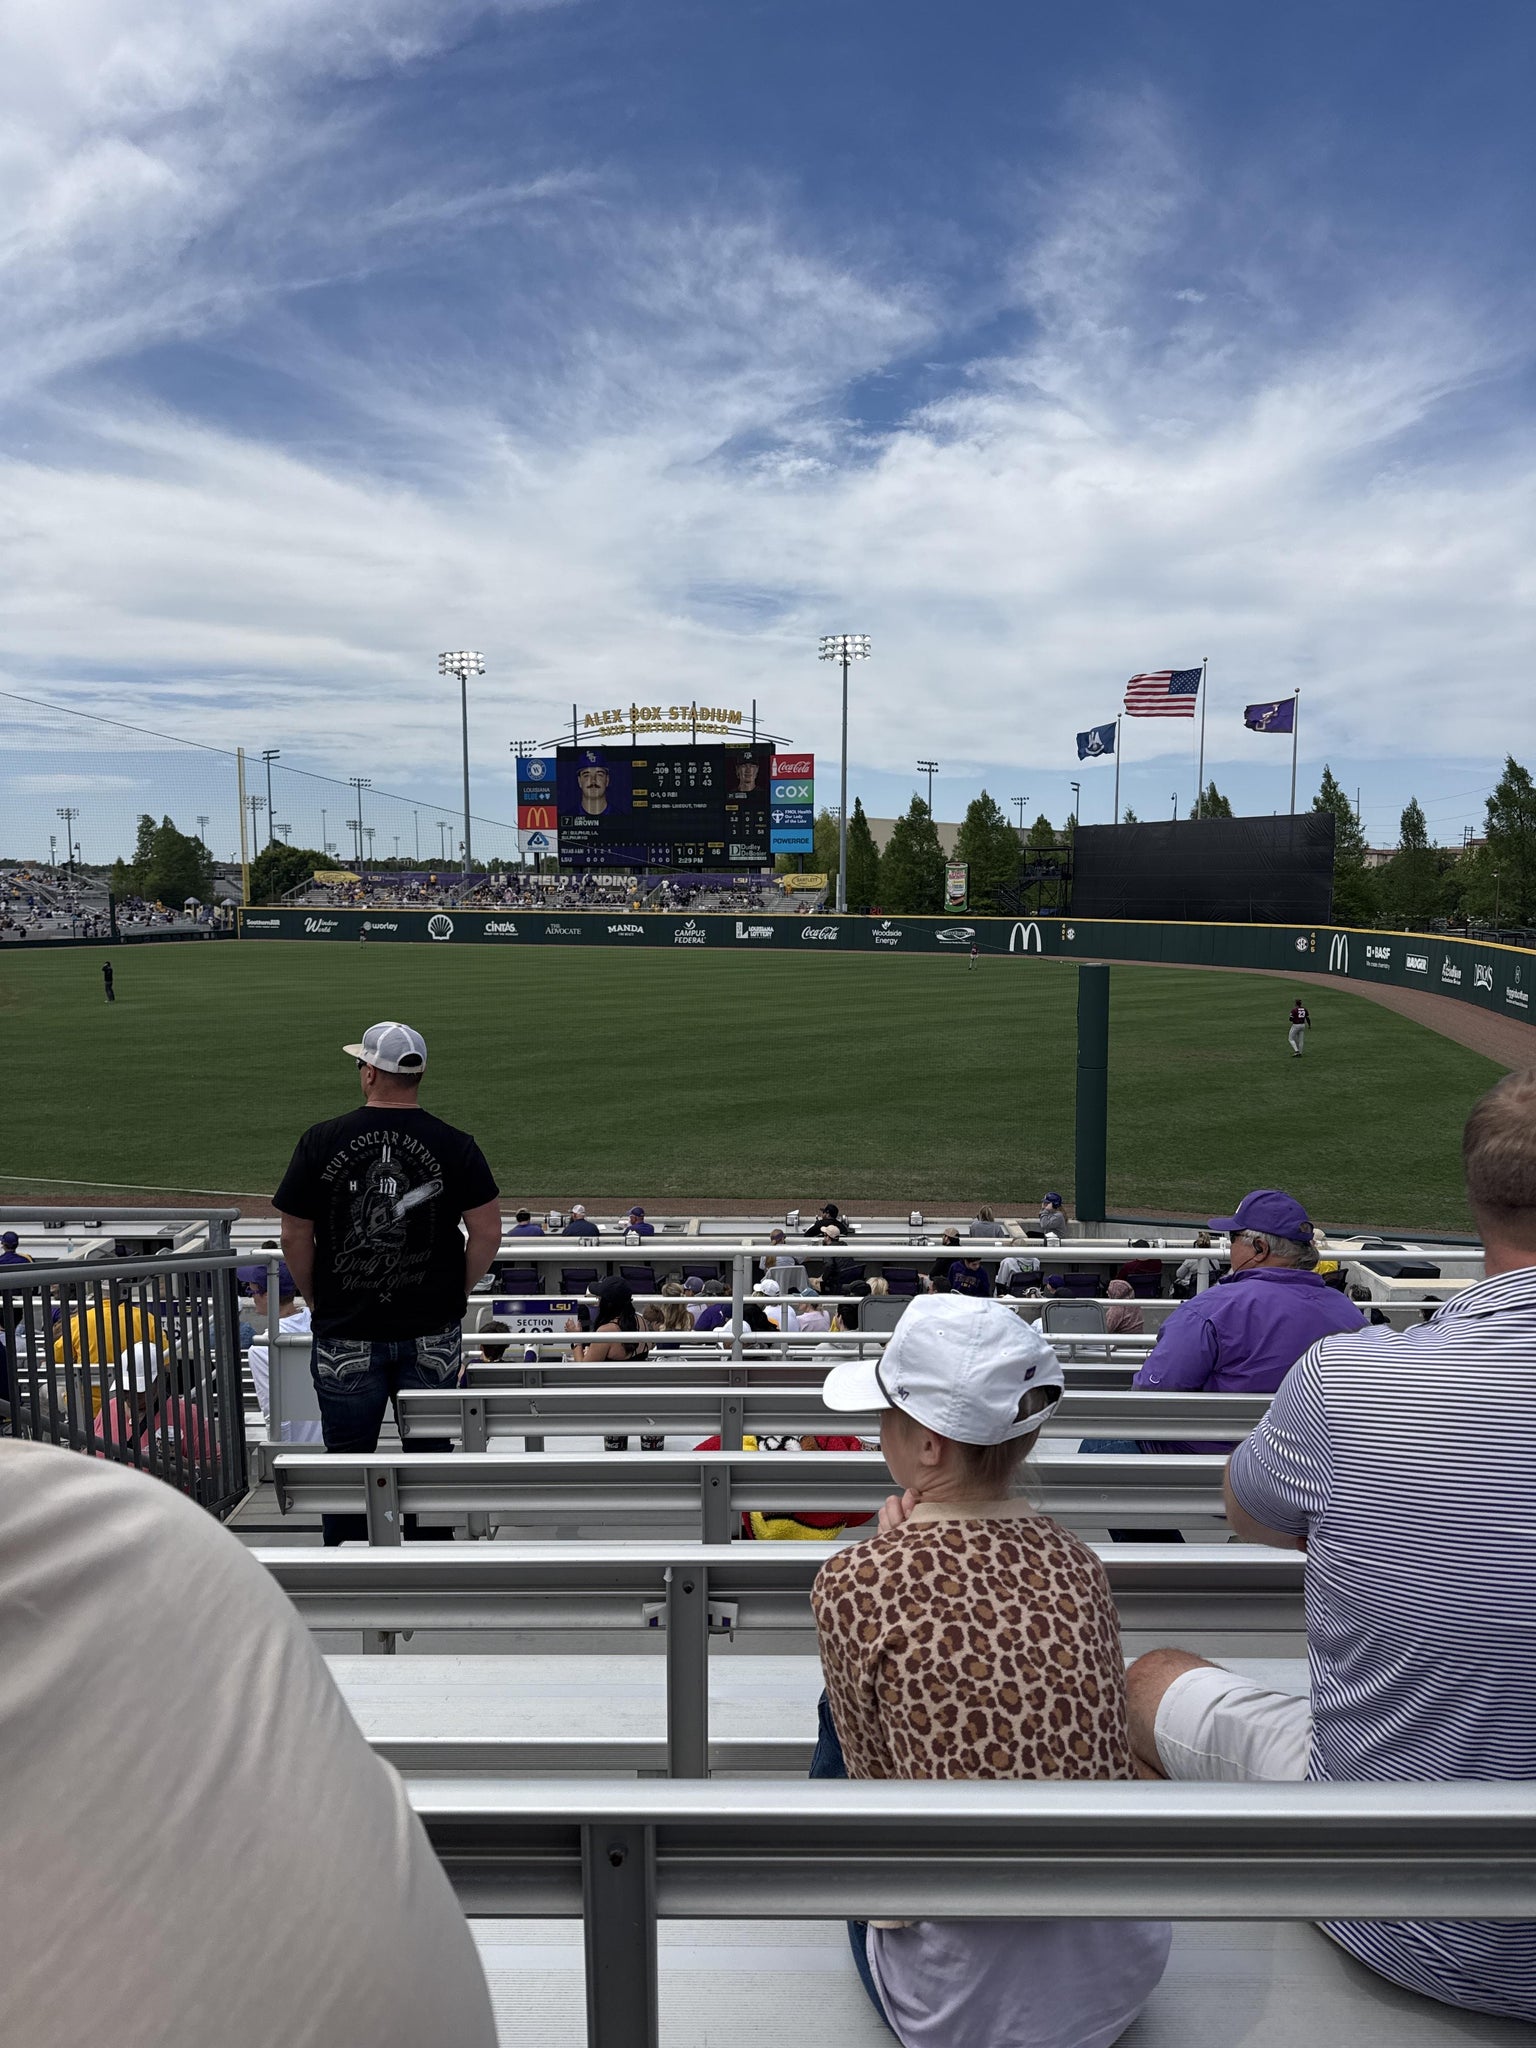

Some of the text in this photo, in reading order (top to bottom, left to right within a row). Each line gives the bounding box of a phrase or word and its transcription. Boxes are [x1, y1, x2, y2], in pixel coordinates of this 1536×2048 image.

[584, 706, 742, 728] ALEX BOX STADIUM
[598, 725, 626, 737] SKIP
[694, 724, 729, 735] FIELD
[775, 786, 809, 798] COX
[740, 844, 760, 852] Dudley
[491, 876, 638, 886] LET FIELD LNDING
[372, 923, 398, 932] worley
[608, 924, 644, 934] MANDA
[1375, 947, 1390, 959] BASF
[350, 1130, 399, 1151] COLLAR
[402, 1134, 444, 1178] PATRIOT
